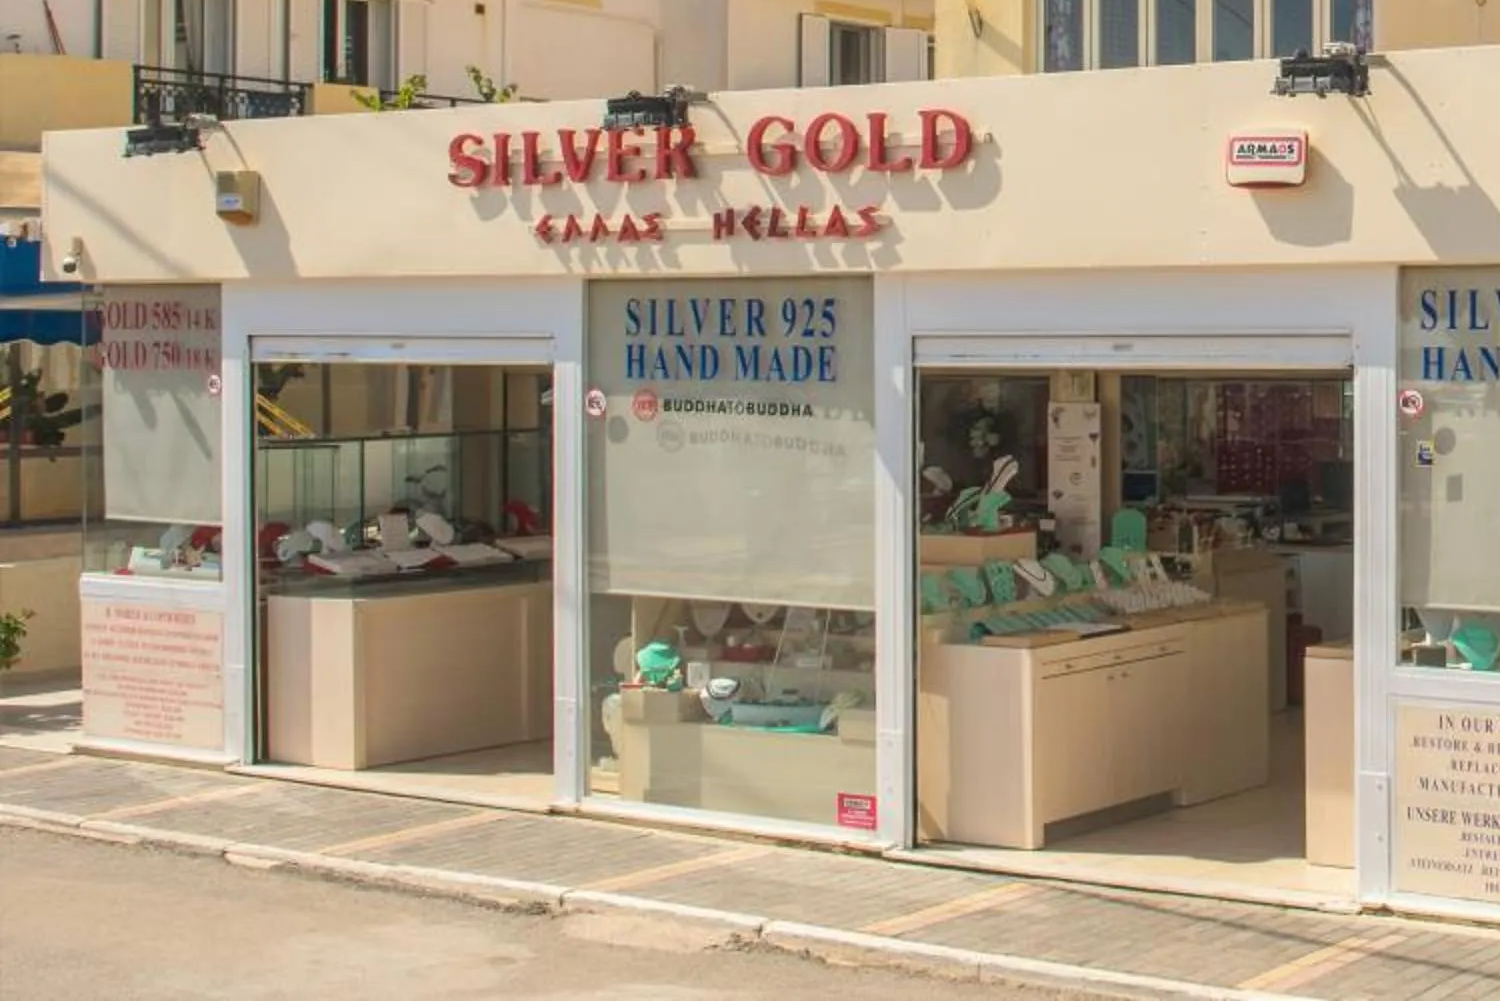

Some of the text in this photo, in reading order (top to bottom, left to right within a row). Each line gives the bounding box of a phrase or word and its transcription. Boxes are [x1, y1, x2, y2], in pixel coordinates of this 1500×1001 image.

[448, 108, 973, 187] SILVER GOLD
[712, 203, 882, 240] HELLAS
[151, 301, 182, 330] 585
[625, 298, 836, 337] SILVER 925
[151, 341, 181, 370] 750
[626, 344, 836, 382] HAND MADE
[1438, 714, 1454, 730] IN
[1461, 717, 1493, 734] OUR
[1407, 806, 1456, 825] UNSERE
